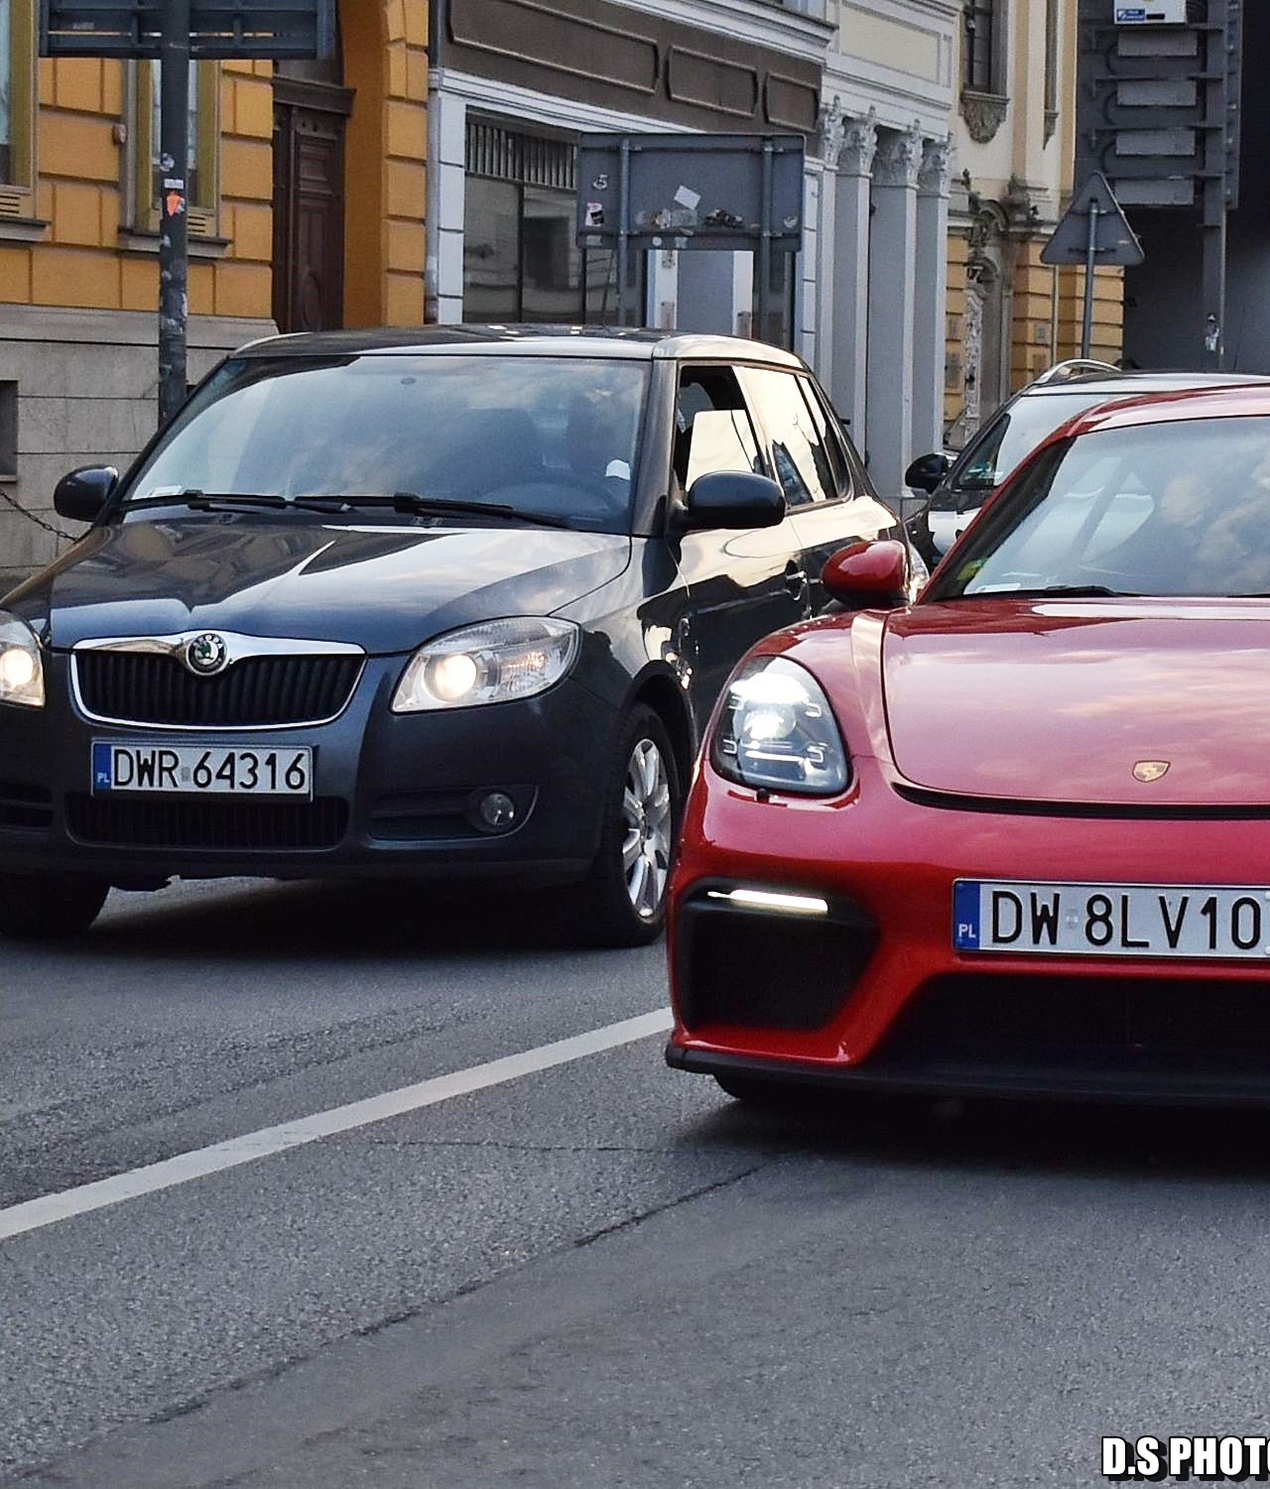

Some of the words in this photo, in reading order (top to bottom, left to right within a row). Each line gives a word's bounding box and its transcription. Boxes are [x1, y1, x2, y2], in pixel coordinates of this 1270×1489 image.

[97, 773, 110, 783] PL
[113, 748, 180, 788] DWR
[192, 750, 305, 790] 64316
[958, 923, 977, 939] PL
[992, 889, 1060, 945] DW
[1085, 893, 1261, 950] 8LV10
